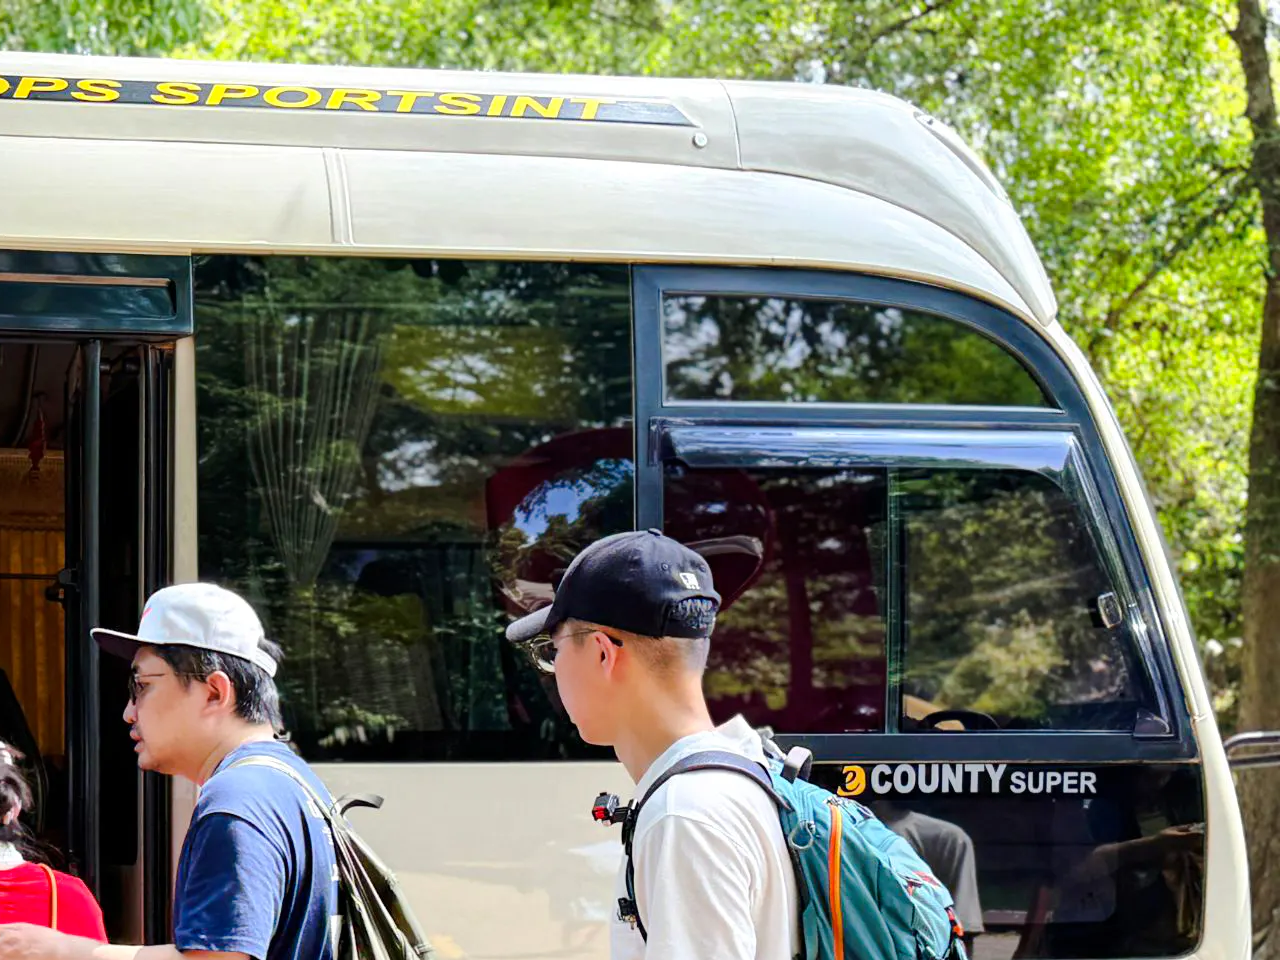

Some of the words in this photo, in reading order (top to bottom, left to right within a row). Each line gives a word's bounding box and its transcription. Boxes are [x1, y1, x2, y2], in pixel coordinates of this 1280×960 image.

[149, 82, 616, 119] SPORTSINT
[871, 763, 1008, 794] COUNTY
[1010, 771, 1097, 794] SUPER
